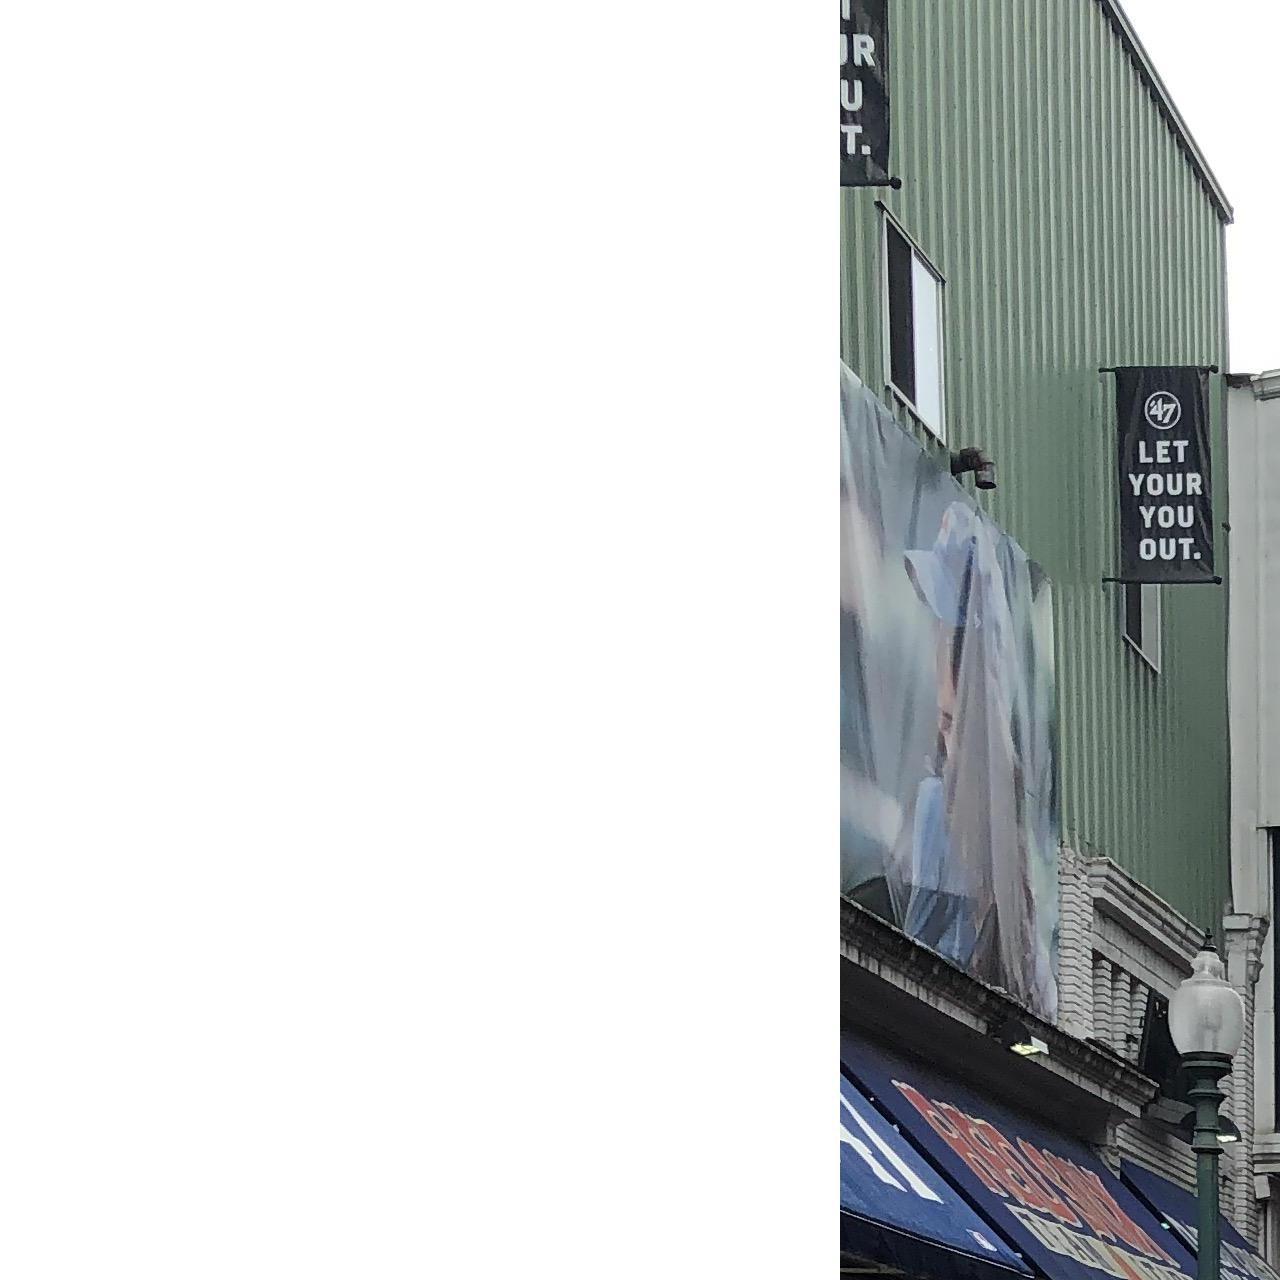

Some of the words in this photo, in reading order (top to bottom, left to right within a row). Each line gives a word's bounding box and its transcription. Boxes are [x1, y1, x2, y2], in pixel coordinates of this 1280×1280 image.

[1138, 440, 1190, 464] LET
[1128, 472, 1203, 497] YOUR
[1139, 505, 1195, 529] YOU
[1139, 537, 1202, 561] OUT.
[890, 1079, 1083, 1228] RED
[1016, 1136, 1181, 1268] SOX
